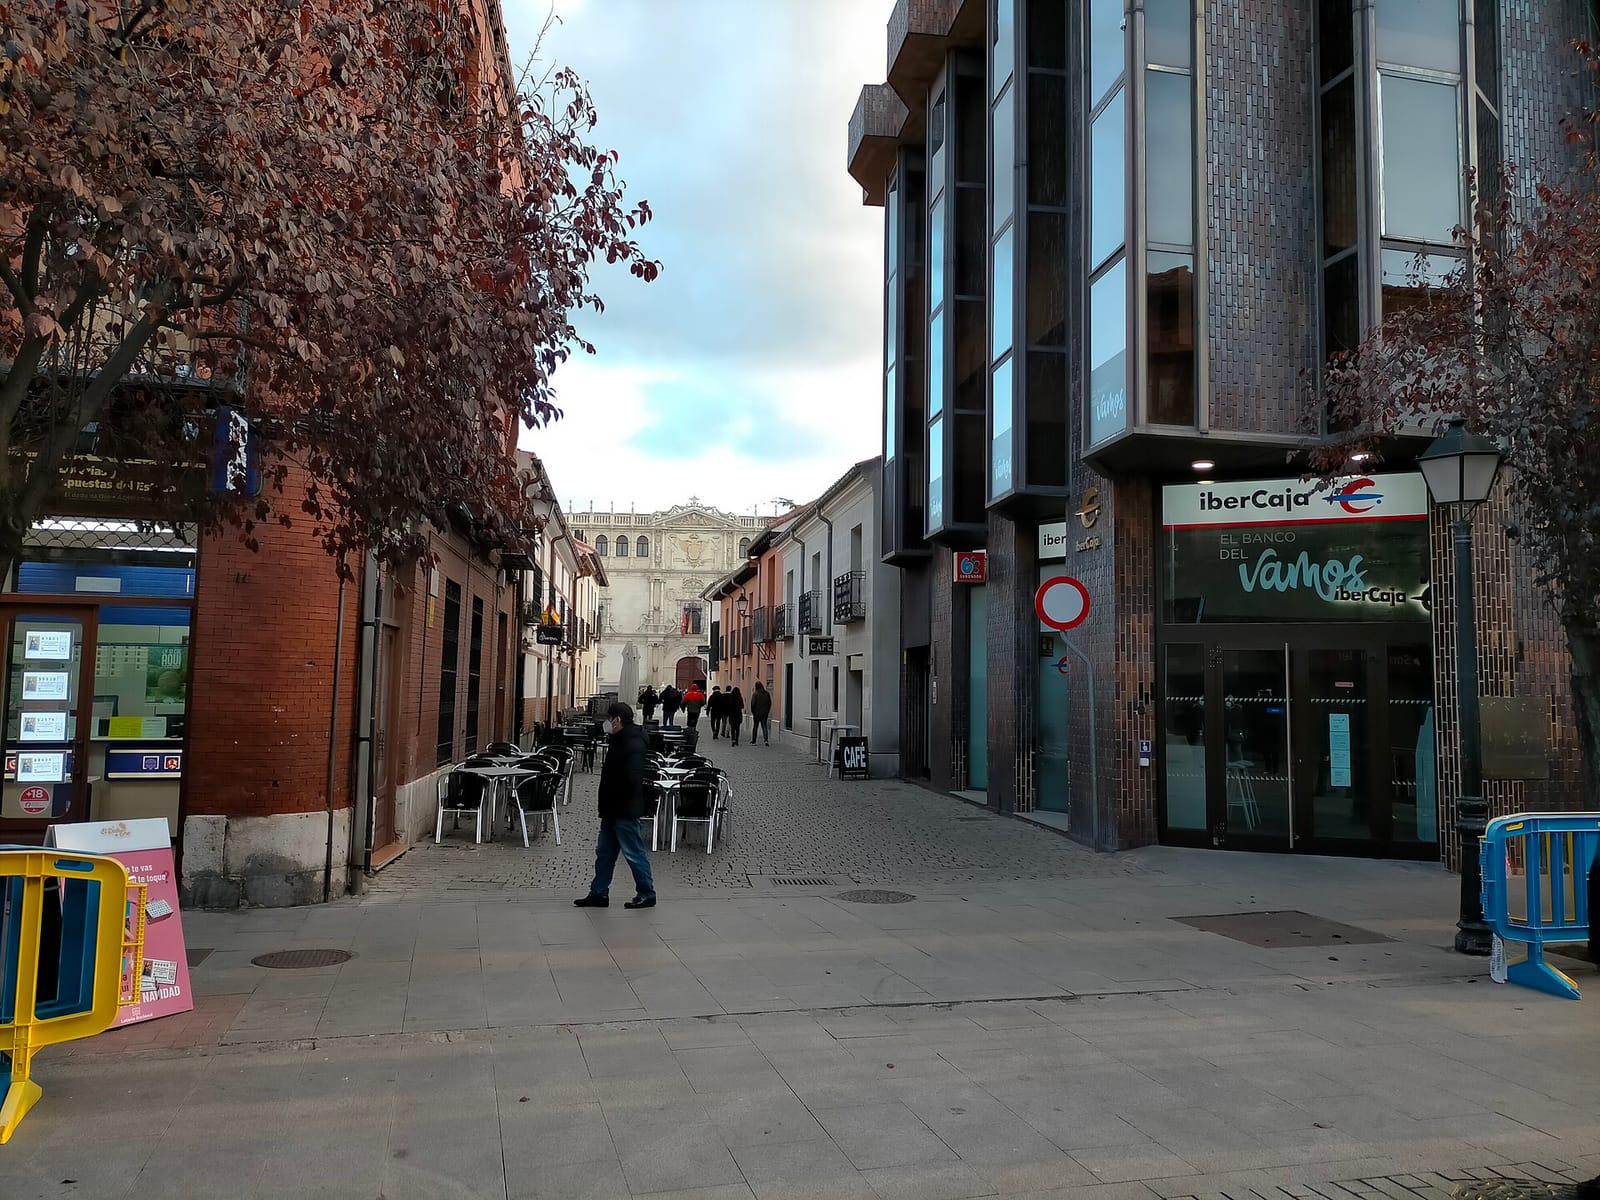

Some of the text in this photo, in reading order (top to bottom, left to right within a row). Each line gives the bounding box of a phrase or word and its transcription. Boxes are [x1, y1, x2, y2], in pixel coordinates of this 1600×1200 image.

[63, 478, 113, 490] puestas
[1199, 487, 1311, 512] iberCaja
[1220, 531, 1296, 545] EL BANCO
[1219, 549, 1249, 561] DEL
[1334, 585, 1407, 606] iberCaja
[810, 639, 833, 652] CAFÉ
[843, 742, 867, 769] CAFÉ
[26, 788, 44, 799] +18
[140, 864, 153, 872] vas
[142, 985, 181, 1003] NAVIDAD
